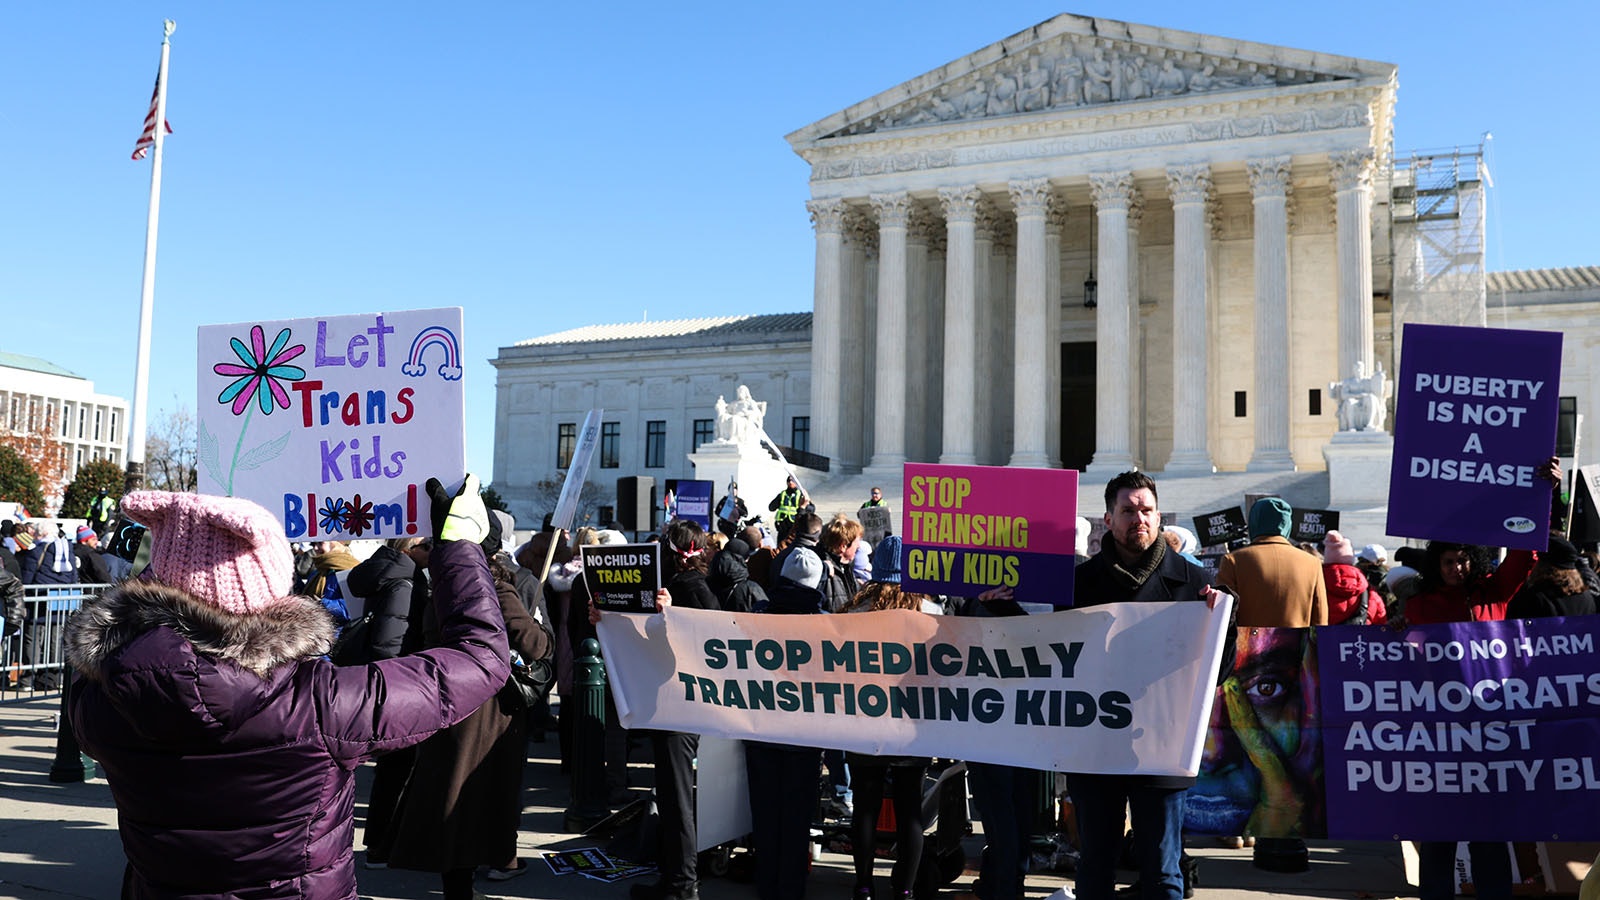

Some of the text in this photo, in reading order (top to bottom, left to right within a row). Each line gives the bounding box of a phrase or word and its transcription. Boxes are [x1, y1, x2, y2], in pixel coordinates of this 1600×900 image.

[315, 315, 394, 368] Let
[1415, 373, 1544, 400] PUBERTY
[292, 380, 415, 428] Trans
[1427, 401, 1527, 428] IS NOT
[320, 435, 407, 484] Kids
[1462, 433, 1484, 454] A
[1410, 457, 1534, 488] DISEASE
[910, 475, 972, 509] STOP
[909, 511, 1029, 549] TRANSING
[1299, 523, 1326, 534] HEALTH
[587, 553, 651, 567] NO CHILD IS
[596, 569, 642, 584] TRANS
[908, 549, 1020, 588] GAY KIDS
[704, 638, 1085, 679] STOP MEDICALLY
[1424, 641, 1464, 663] DO
[1470, 638, 1508, 661] NO
[1513, 633, 1594, 658] HARM
[678, 672, 1133, 729] TRANSITIONING KIDS
[1344, 718, 1537, 752] AGAINST
[1346, 759, 1544, 793] PUBERTY
